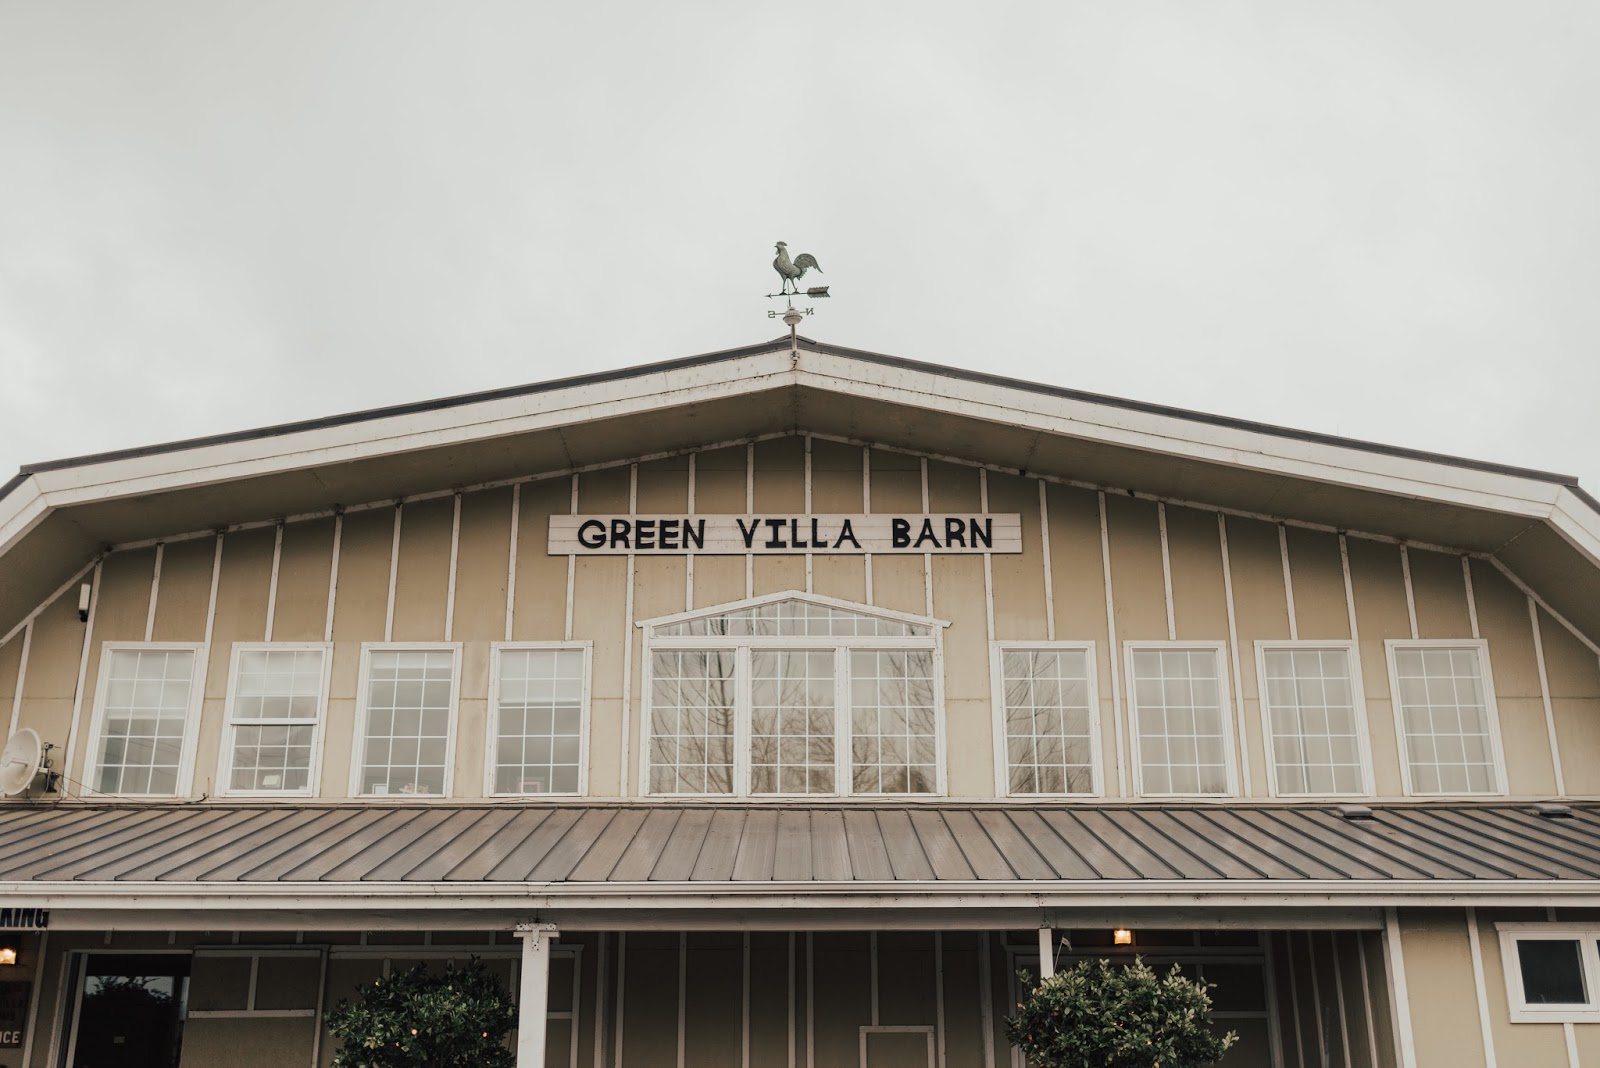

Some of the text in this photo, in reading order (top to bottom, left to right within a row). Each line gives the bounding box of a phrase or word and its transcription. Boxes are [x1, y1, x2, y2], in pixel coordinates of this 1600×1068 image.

[578, 518, 992, 549] GREEN VILLA BARN
